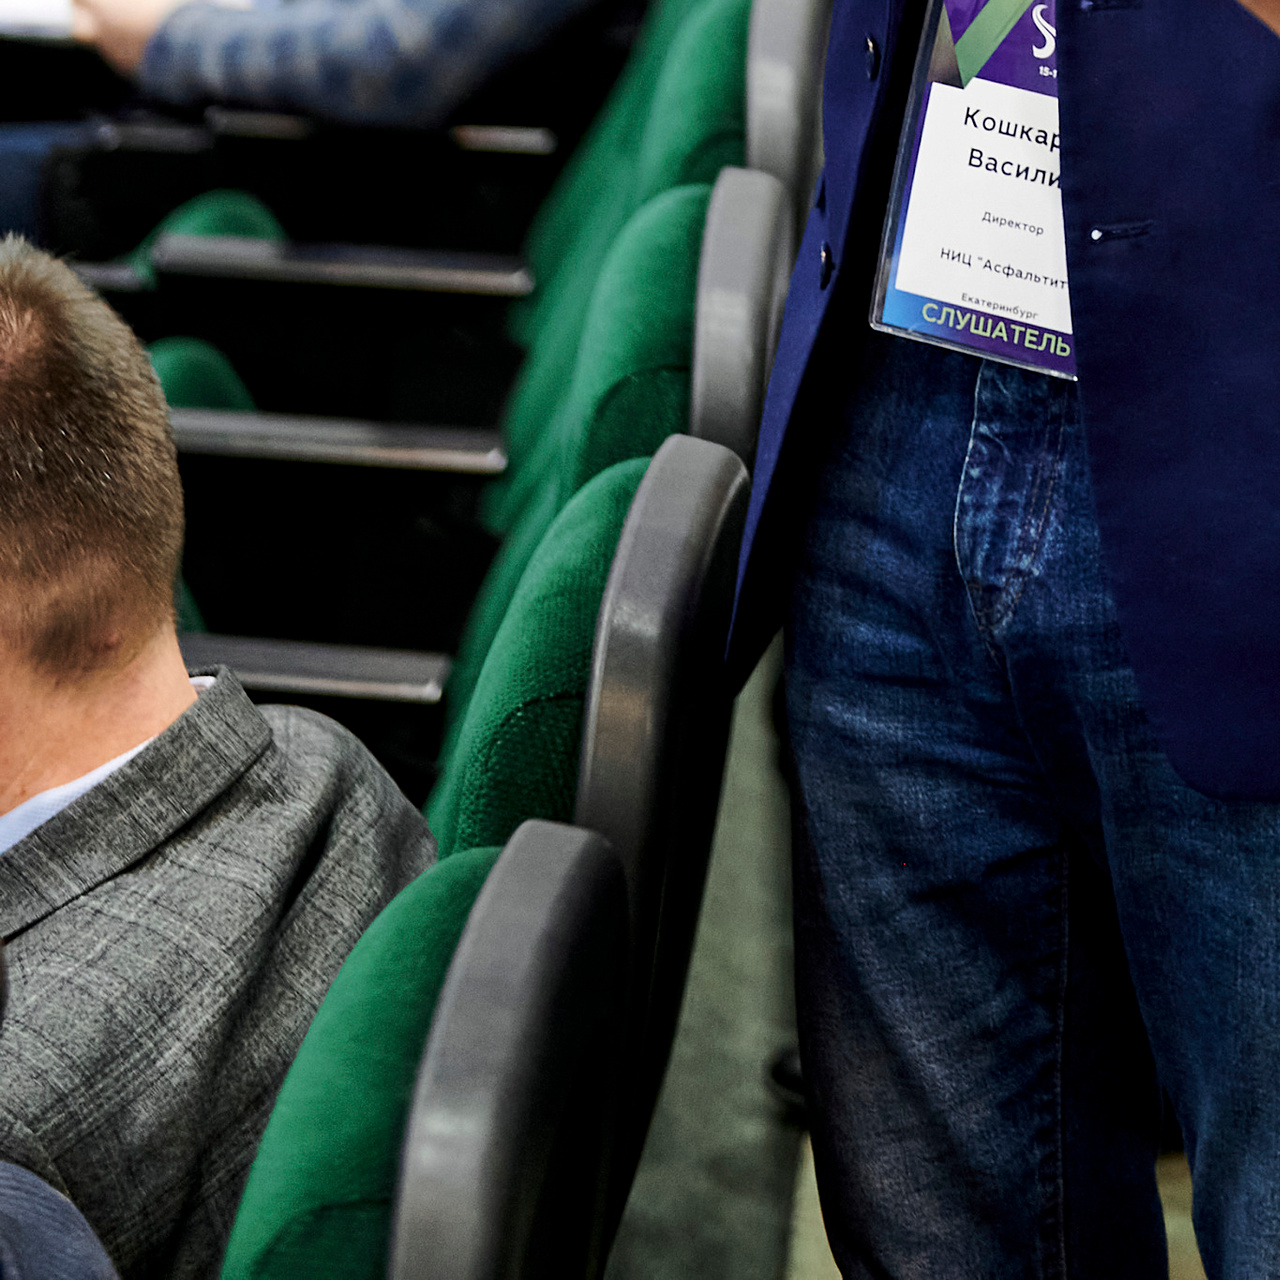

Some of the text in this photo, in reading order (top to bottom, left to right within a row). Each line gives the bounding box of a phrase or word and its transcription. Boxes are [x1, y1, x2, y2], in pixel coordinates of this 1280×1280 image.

[963, 106, 1061, 153] Кошкар
[968, 147, 1062, 189] Васили
[981, 211, 1045, 236] Директор
[940, 247, 972, 268] НИЦ
[961, 292, 1039, 320] Екатеринбург
[921, 302, 1072, 358] СЛУШАТЕЛЬ
